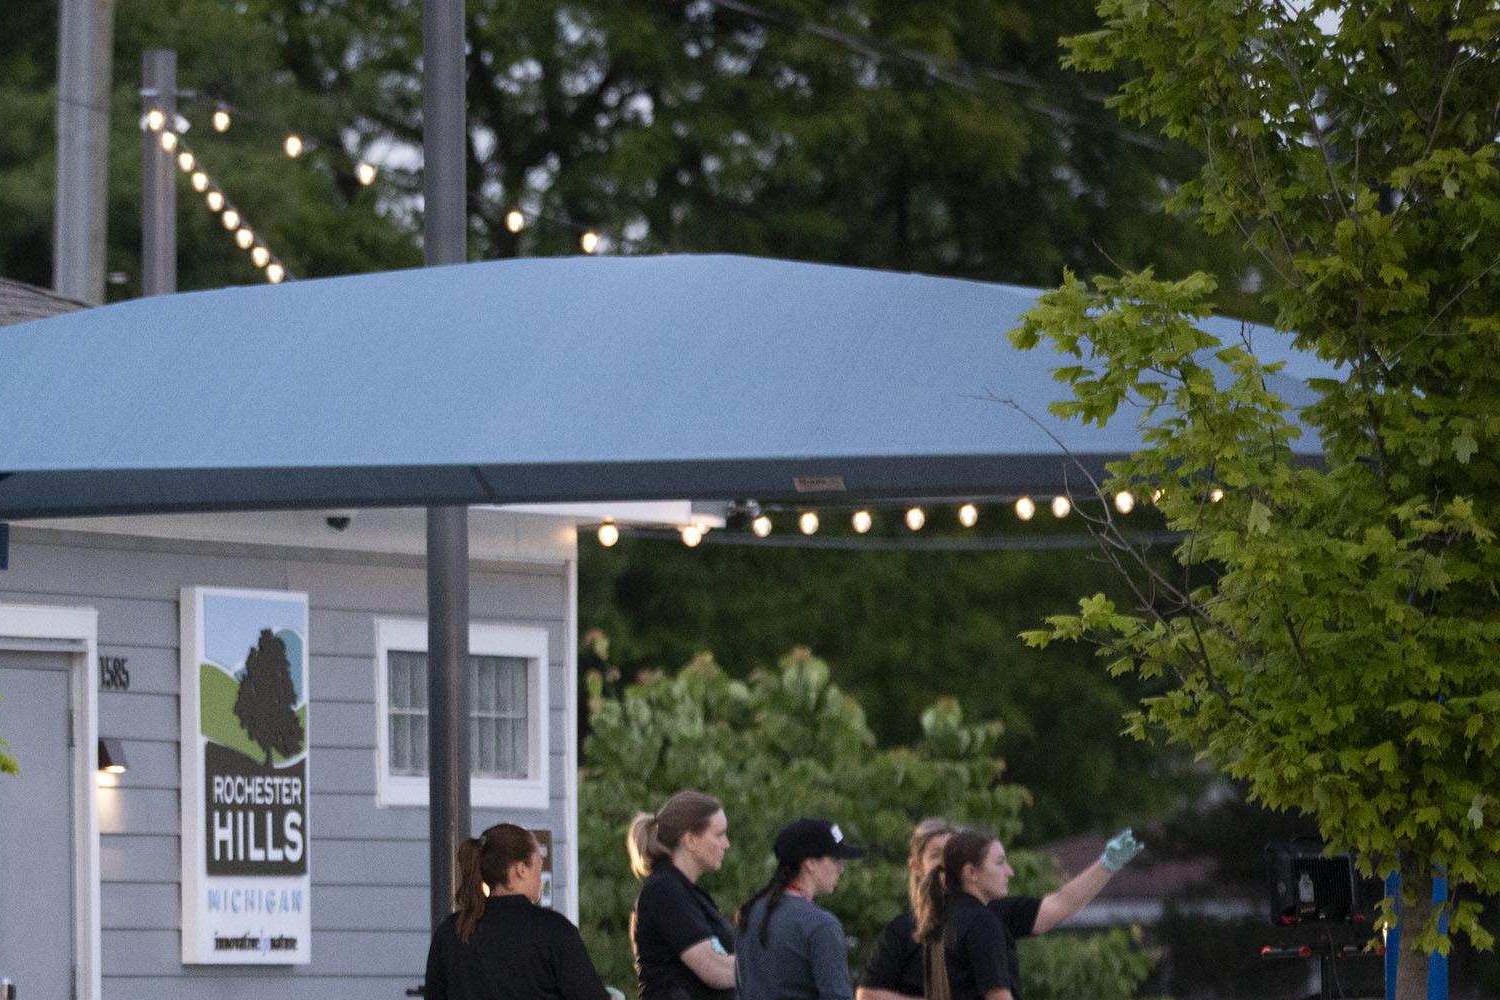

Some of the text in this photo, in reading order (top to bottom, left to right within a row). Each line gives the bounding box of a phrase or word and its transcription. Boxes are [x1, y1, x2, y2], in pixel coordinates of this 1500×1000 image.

[213, 775, 302, 805] ROCHESTER
[213, 809, 304, 863] HILLS
[207, 888, 302, 914] MICHIGAN
